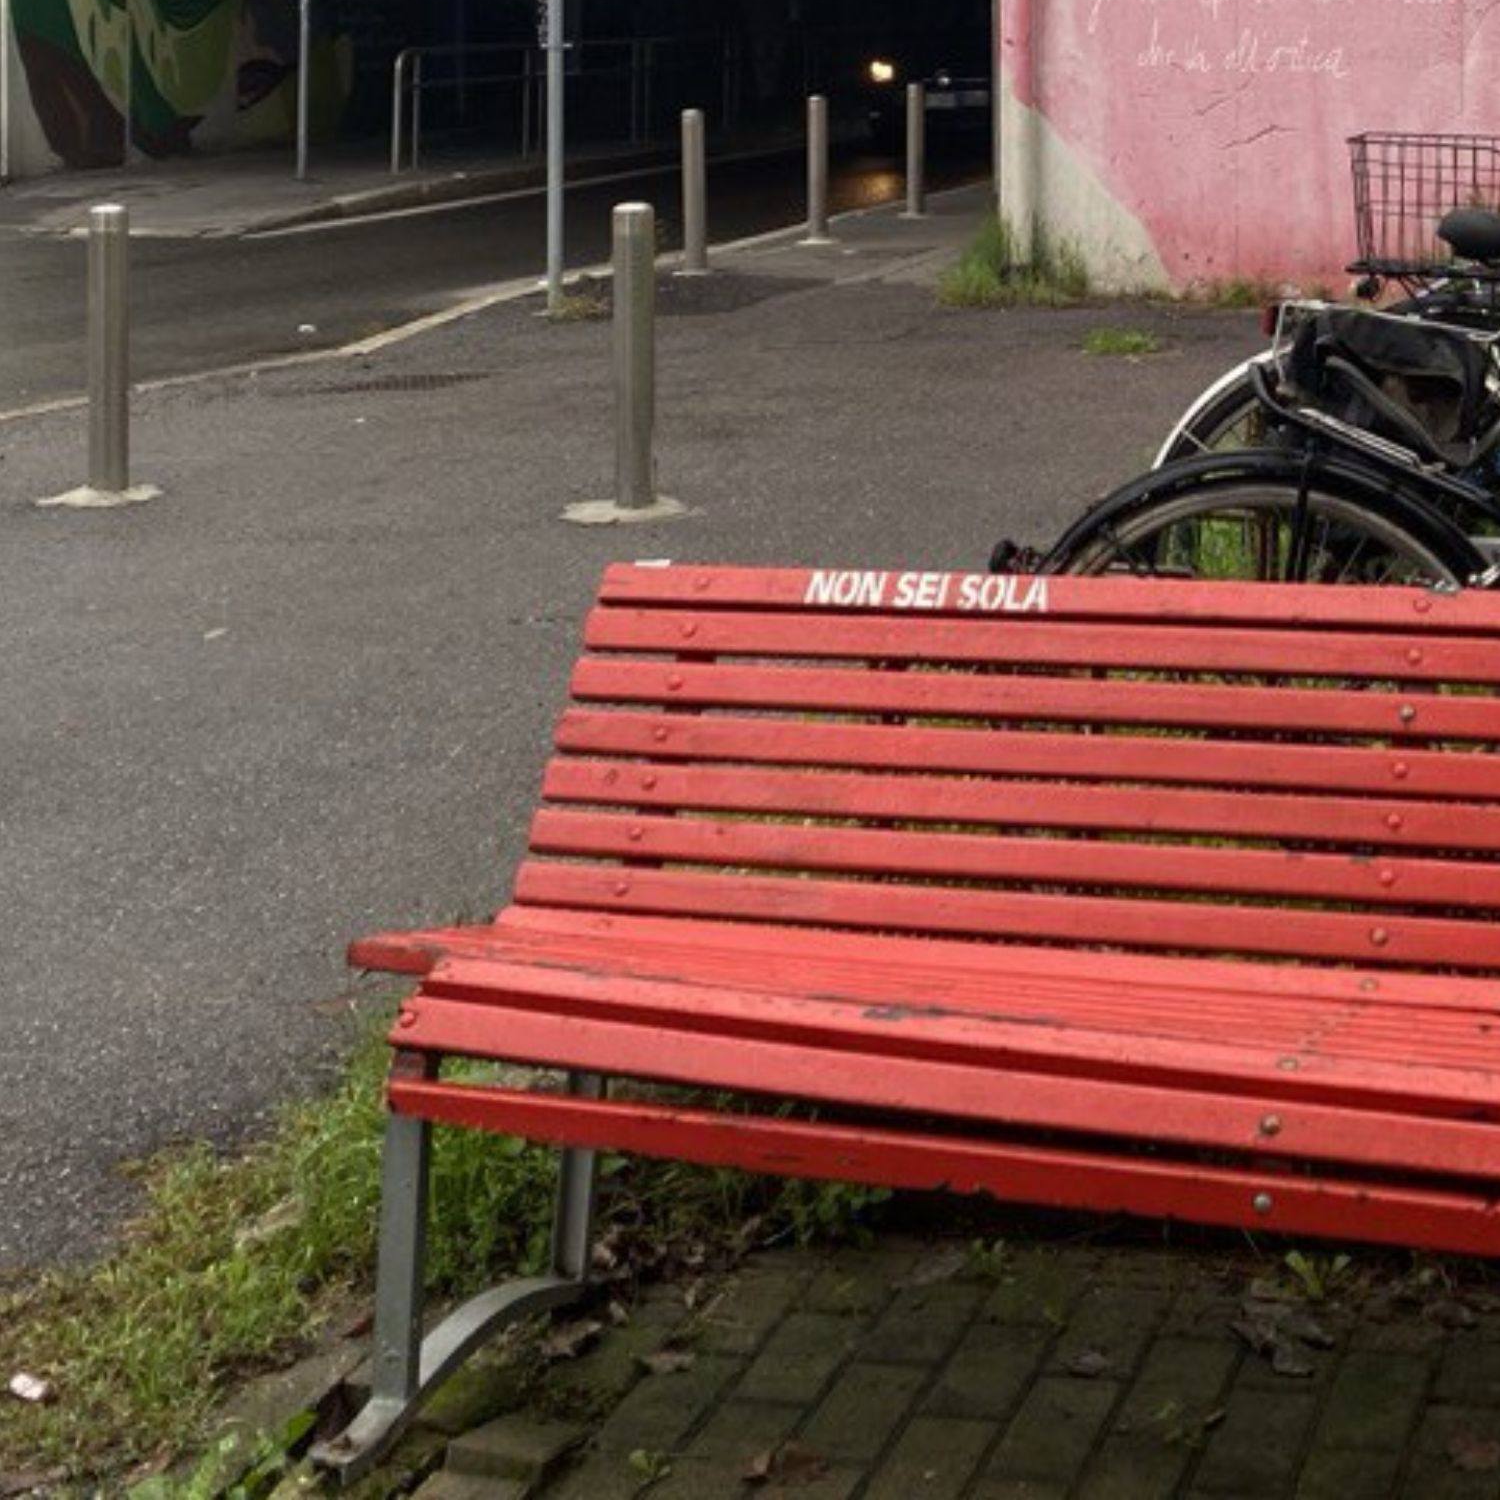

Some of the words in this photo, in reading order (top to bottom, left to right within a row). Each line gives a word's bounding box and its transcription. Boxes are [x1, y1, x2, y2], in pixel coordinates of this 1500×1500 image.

[803, 570, 887, 607] NON
[891, 572, 951, 610] SEI
[955, 575, 1050, 612] SOLA
